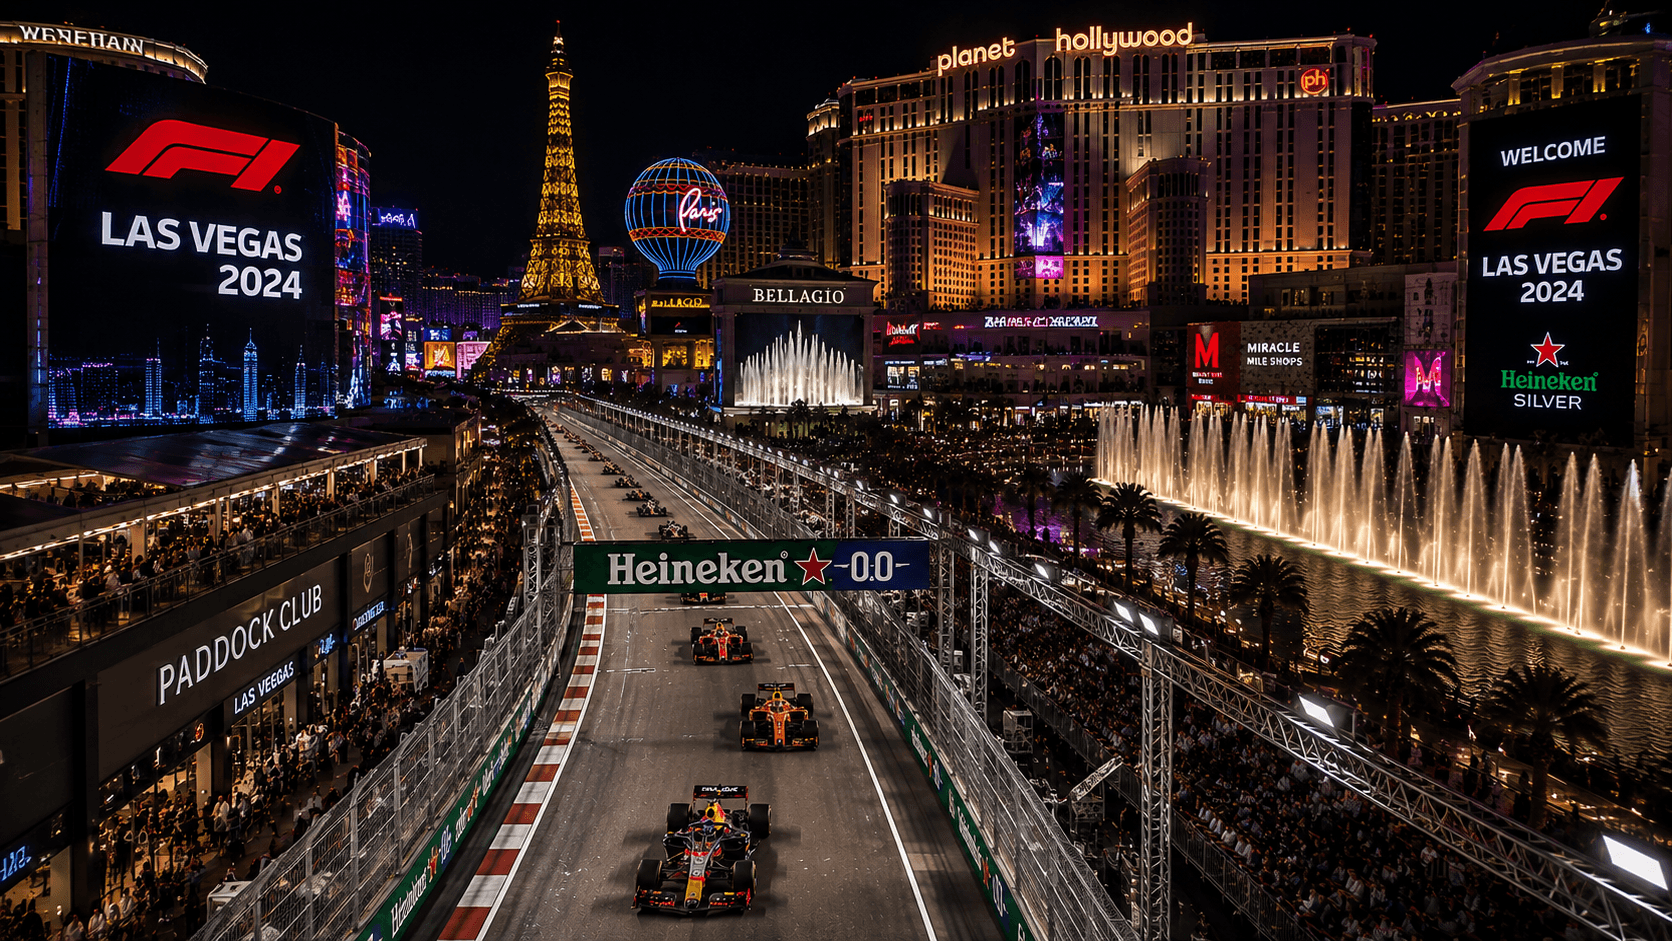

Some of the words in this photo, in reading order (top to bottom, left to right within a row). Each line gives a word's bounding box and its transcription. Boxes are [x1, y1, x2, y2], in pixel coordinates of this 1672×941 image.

[938, 37, 1016, 76] planet
[1056, 22, 1193, 56] hollywood
[1305, 69, 1325, 89] ph
[1500, 136, 1606, 167] WELCOME
[679, 187, 723, 233] Paris
[101, 211, 181, 250] LAS
[188, 218, 303, 263] VEGAS
[1482, 255, 1529, 277] LAS
[1533, 248, 1623, 275] VEGAS
[217, 264, 304, 299] 2024
[752, 287, 844, 304] BELLAGIO
[1520, 280, 1585, 303] 2024
[1195, 332, 1219, 368] M
[1247, 342, 1300, 353] MIRACLE
[1247, 356, 1268, 366] MILE
[1270, 357, 1303, 367] SHOPS
[1500, 369, 1597, 392] Heineken
[1514, 393, 1582, 410] SILVER
[607, 551, 787, 585] Heineken
[159, 608, 275, 706] PADDOCK
[279, 584, 322, 632] CLUB
[234, 687, 256, 715] LAS
